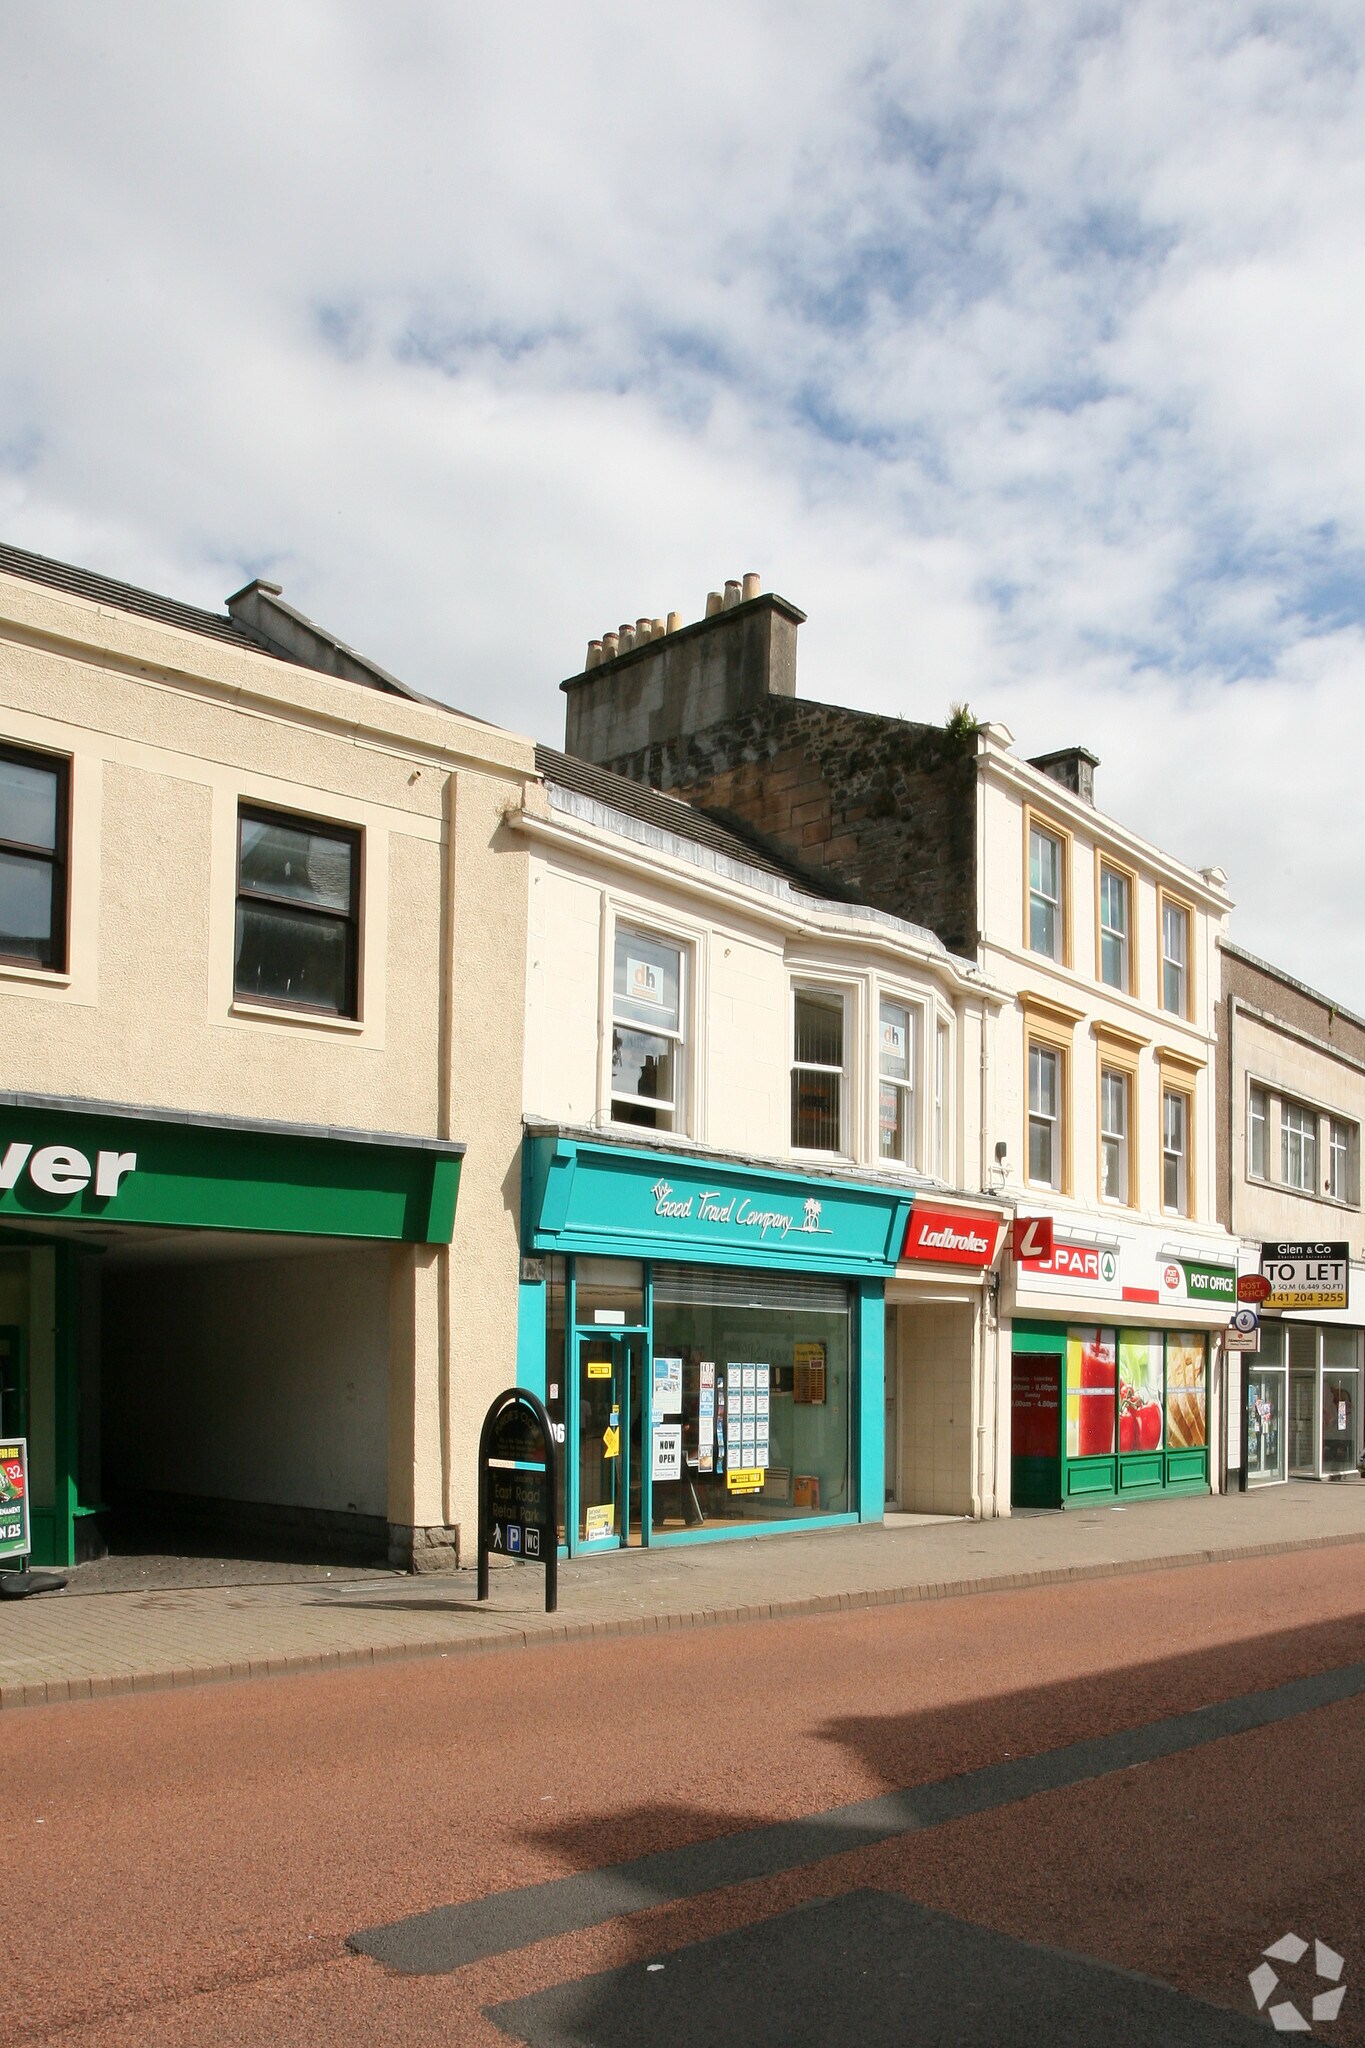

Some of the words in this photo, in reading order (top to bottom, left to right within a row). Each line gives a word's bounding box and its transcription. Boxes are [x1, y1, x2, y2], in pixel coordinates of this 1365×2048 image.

[656, 1190, 693, 1218] Good
[698, 1191, 736, 1223] Travel
[736, 1199, 793, 1239] Company
[918, 1225, 989, 1253] Ladbrokes
[1277, 1243, 1303, 1255] Glen
[1306, 1246, 1313, 1254] &
[1314, 1243, 1332, 1254] Co
[1166, 1268, 1177, 1277] POST
[1265, 1263, 1296, 1281] TO
[1306, 1263, 1344, 1281] LET
[1166, 1276, 1179, 1285] OFFICE
[1191, 1273, 1209, 1289] POST
[1209, 1276, 1234, 1292] OFFICE
[1240, 1281, 1261, 1289] POST
[1238, 1289, 1265, 1298] OFFICE
[1294, 1293, 1314, 1302] 204
[1318, 1293, 1344, 1302] 3255
[659, 1440, 675, 1450] NOW
[659, 1454, 675, 1464] OPEN
[7, 1464, 23, 1480] 32
[495, 1484, 512, 1500] East
[515, 1486, 540, 1504] Road
[492, 1502, 517, 1520] Retail
[520, 1506, 540, 1522] Park
[7, 1523, 21, 1538] £25
[526, 1533, 538, 1550] WC
